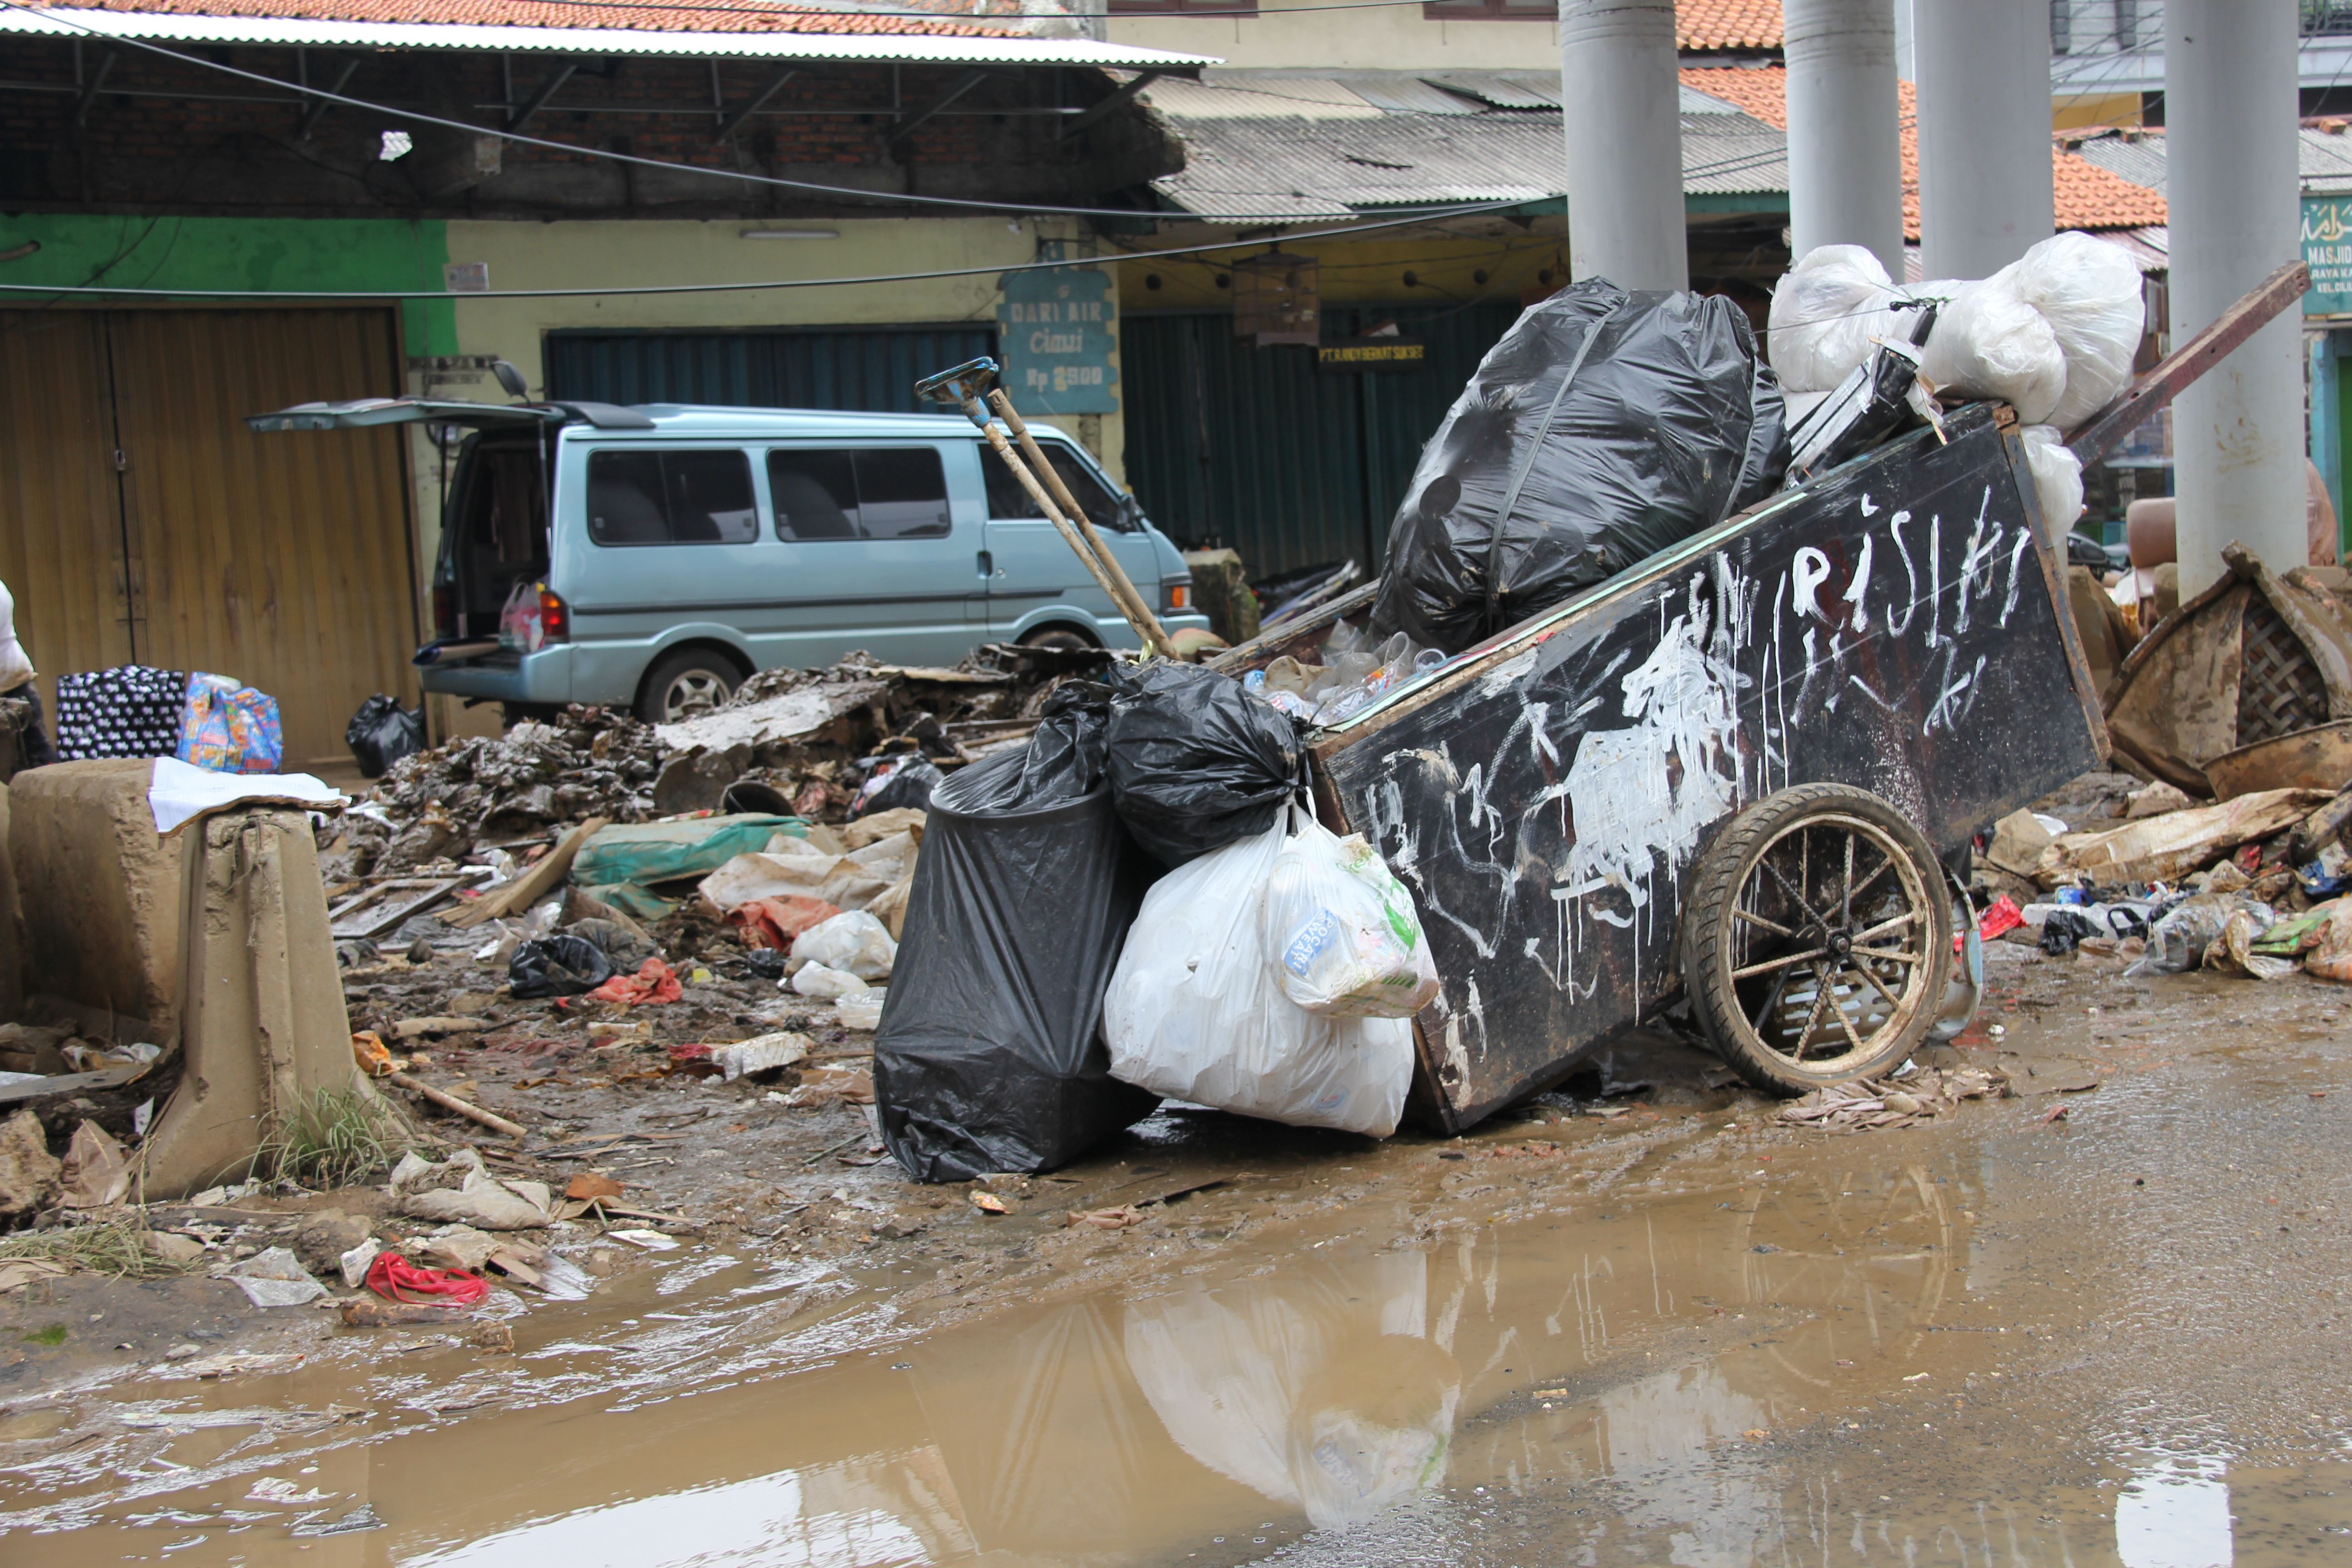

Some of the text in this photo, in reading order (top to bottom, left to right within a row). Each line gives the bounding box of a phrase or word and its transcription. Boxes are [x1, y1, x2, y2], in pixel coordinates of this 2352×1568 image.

[1010, 302, 1102, 322] DARI AIR
[1290, 912, 1327, 960] SWEAT
[1293, 917, 1335, 970] POCARI
